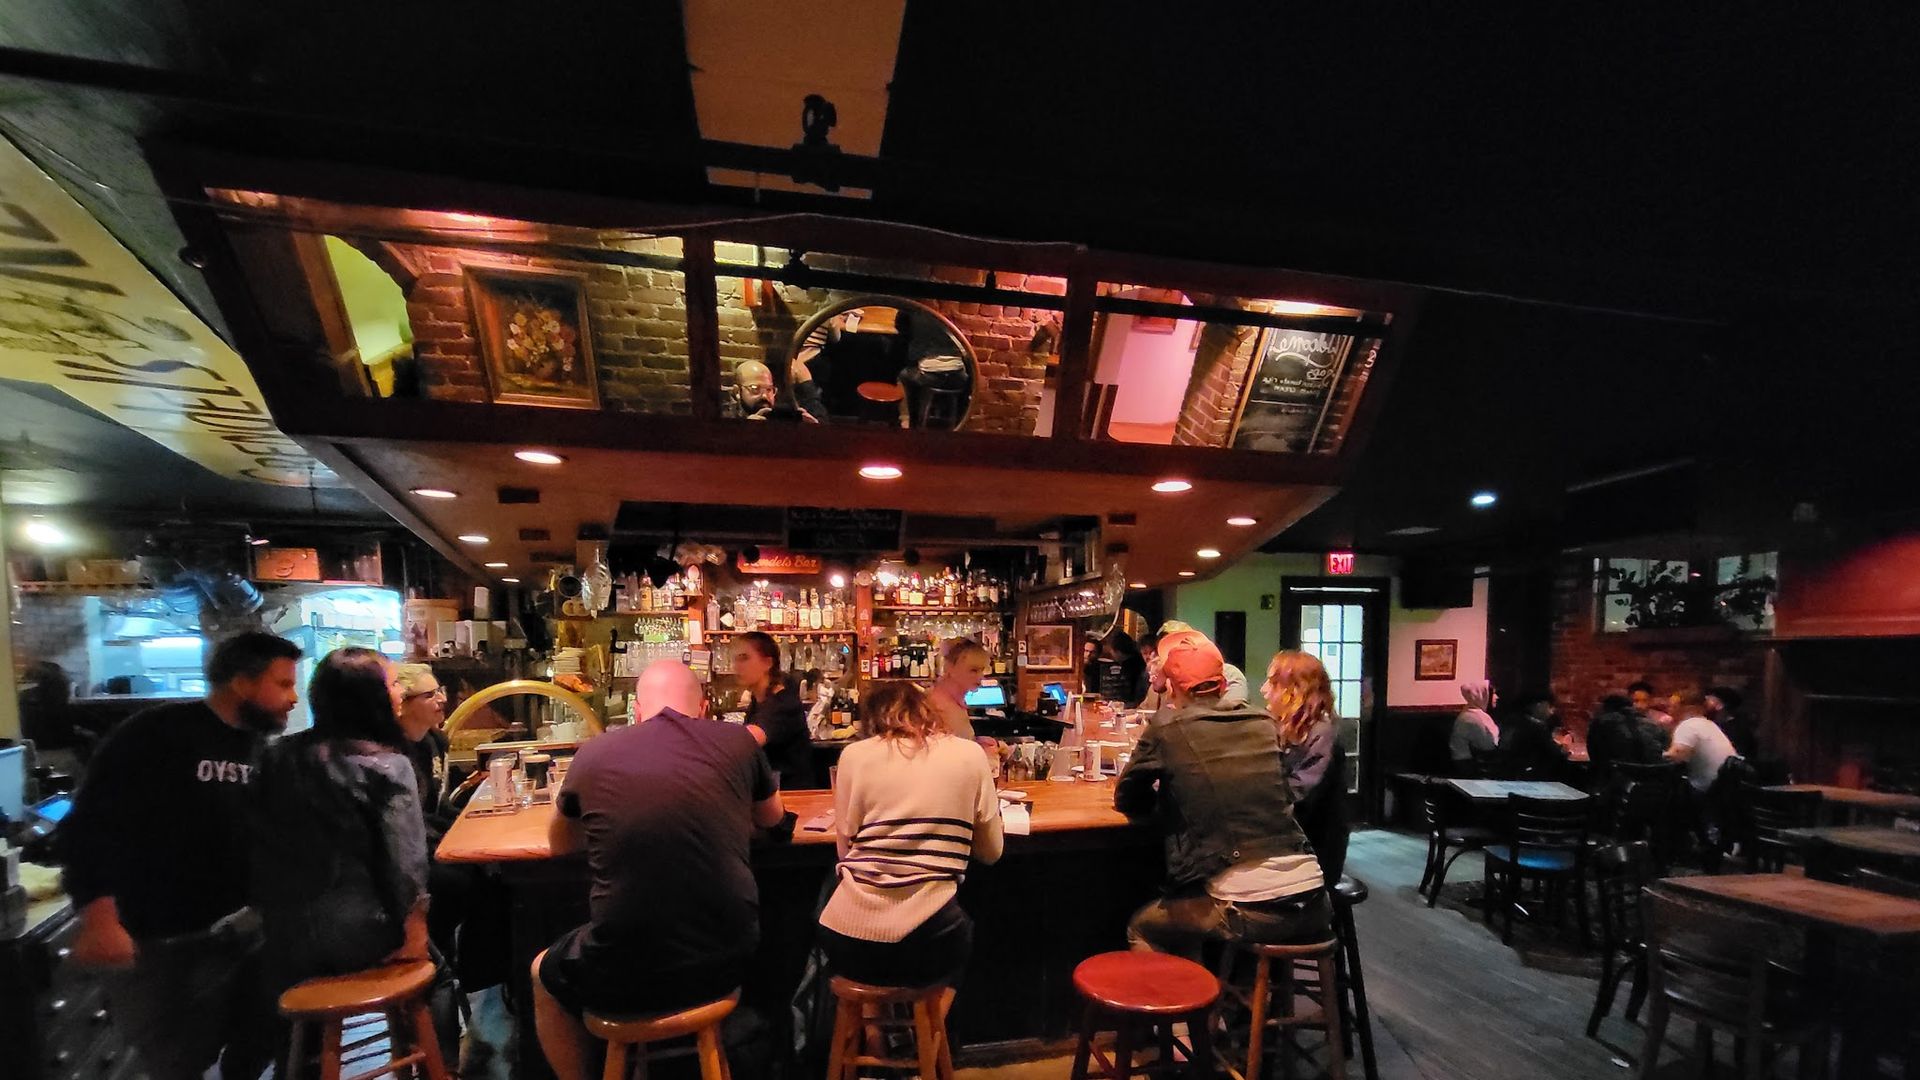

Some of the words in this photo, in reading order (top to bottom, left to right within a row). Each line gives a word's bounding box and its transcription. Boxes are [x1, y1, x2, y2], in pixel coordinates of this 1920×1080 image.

[743, 555, 792, 567] ndels
[794, 555, 817, 567] Bar
[1330, 553, 1354, 574] EXIT
